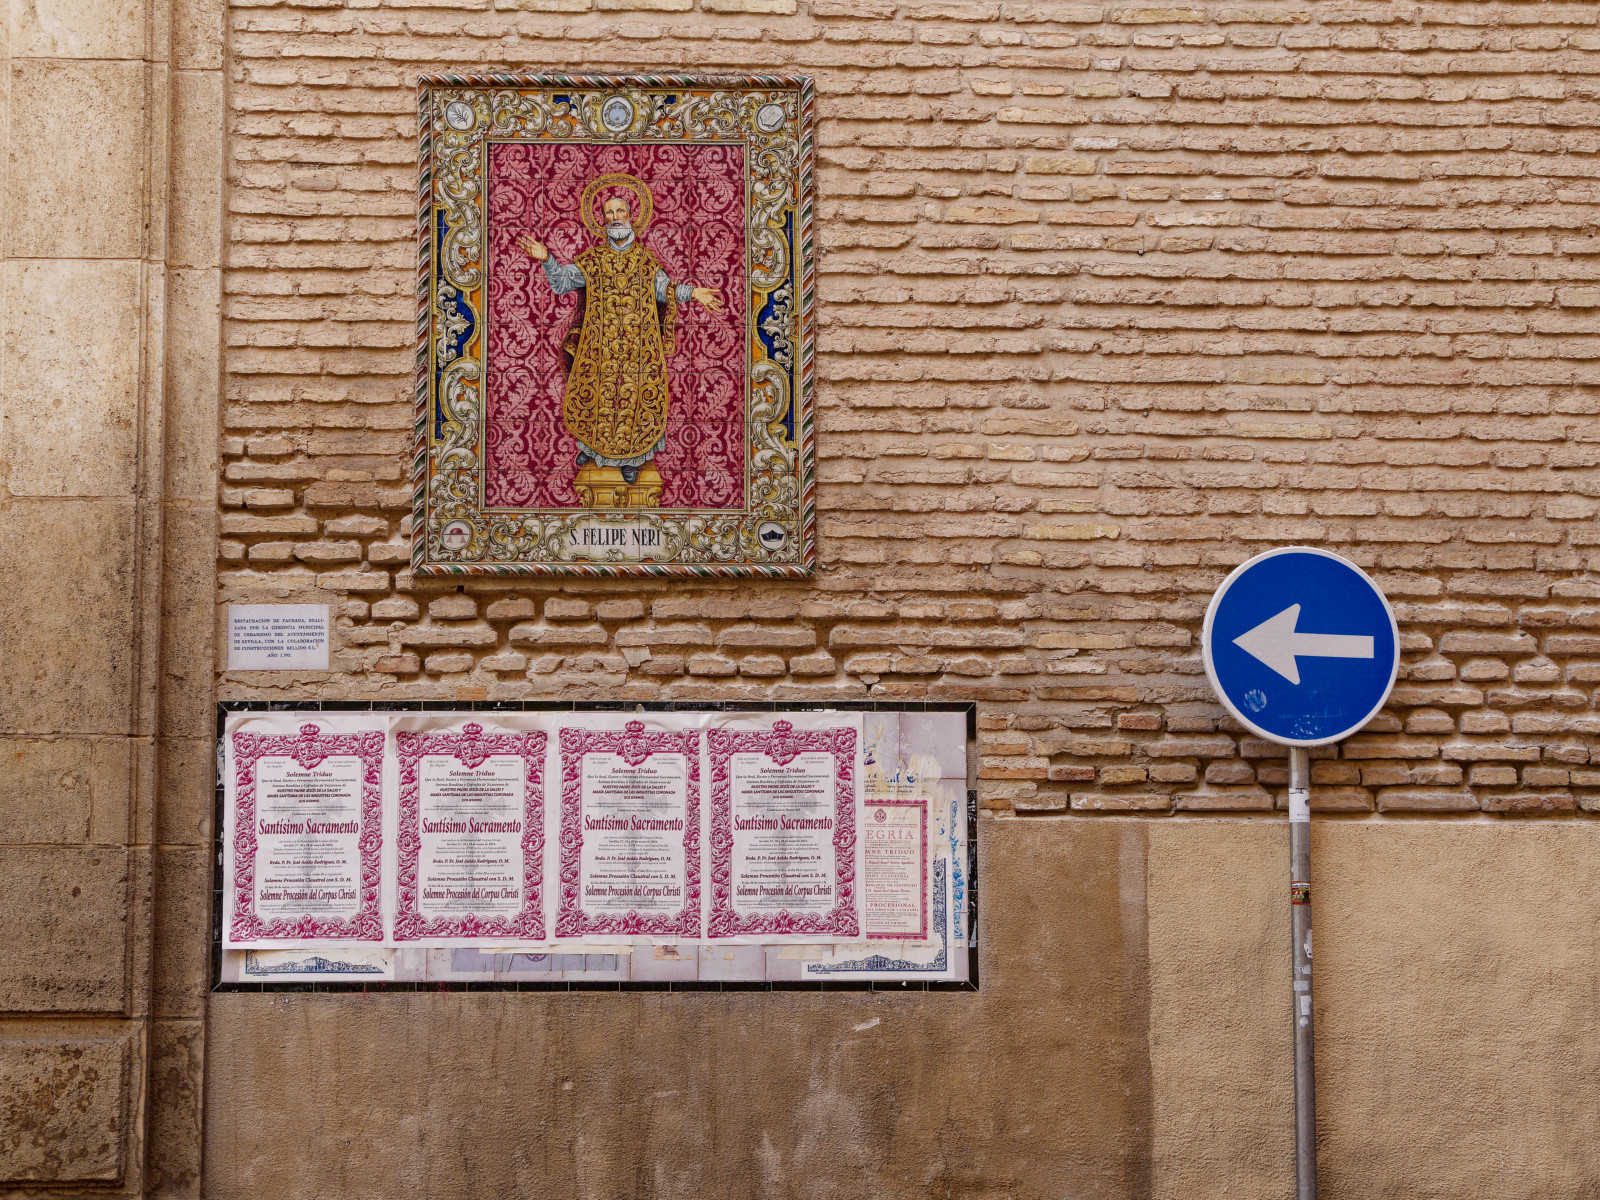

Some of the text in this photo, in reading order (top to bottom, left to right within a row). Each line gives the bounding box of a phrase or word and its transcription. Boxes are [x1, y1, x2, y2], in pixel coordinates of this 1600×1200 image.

[569, 528, 661, 546] S. FELIPE NERI
[259, 819, 358, 835] Santísimo Sacramento
[422, 817, 521, 833] Santísimo Sacramento
[584, 814, 683, 831] Santísimo Sacramento
[734, 814, 832, 830] Santísimo Sacramento
[260, 889, 356, 903] Solemne Procesión del Corpus Christi
[423, 888, 519, 902] Solemne Procesión del Corpus Christi
[585, 885, 681, 899] Solemne Procesión del Corpus Christi
[736, 885, 832, 898] Solemne Procesión del Corpus Christi
